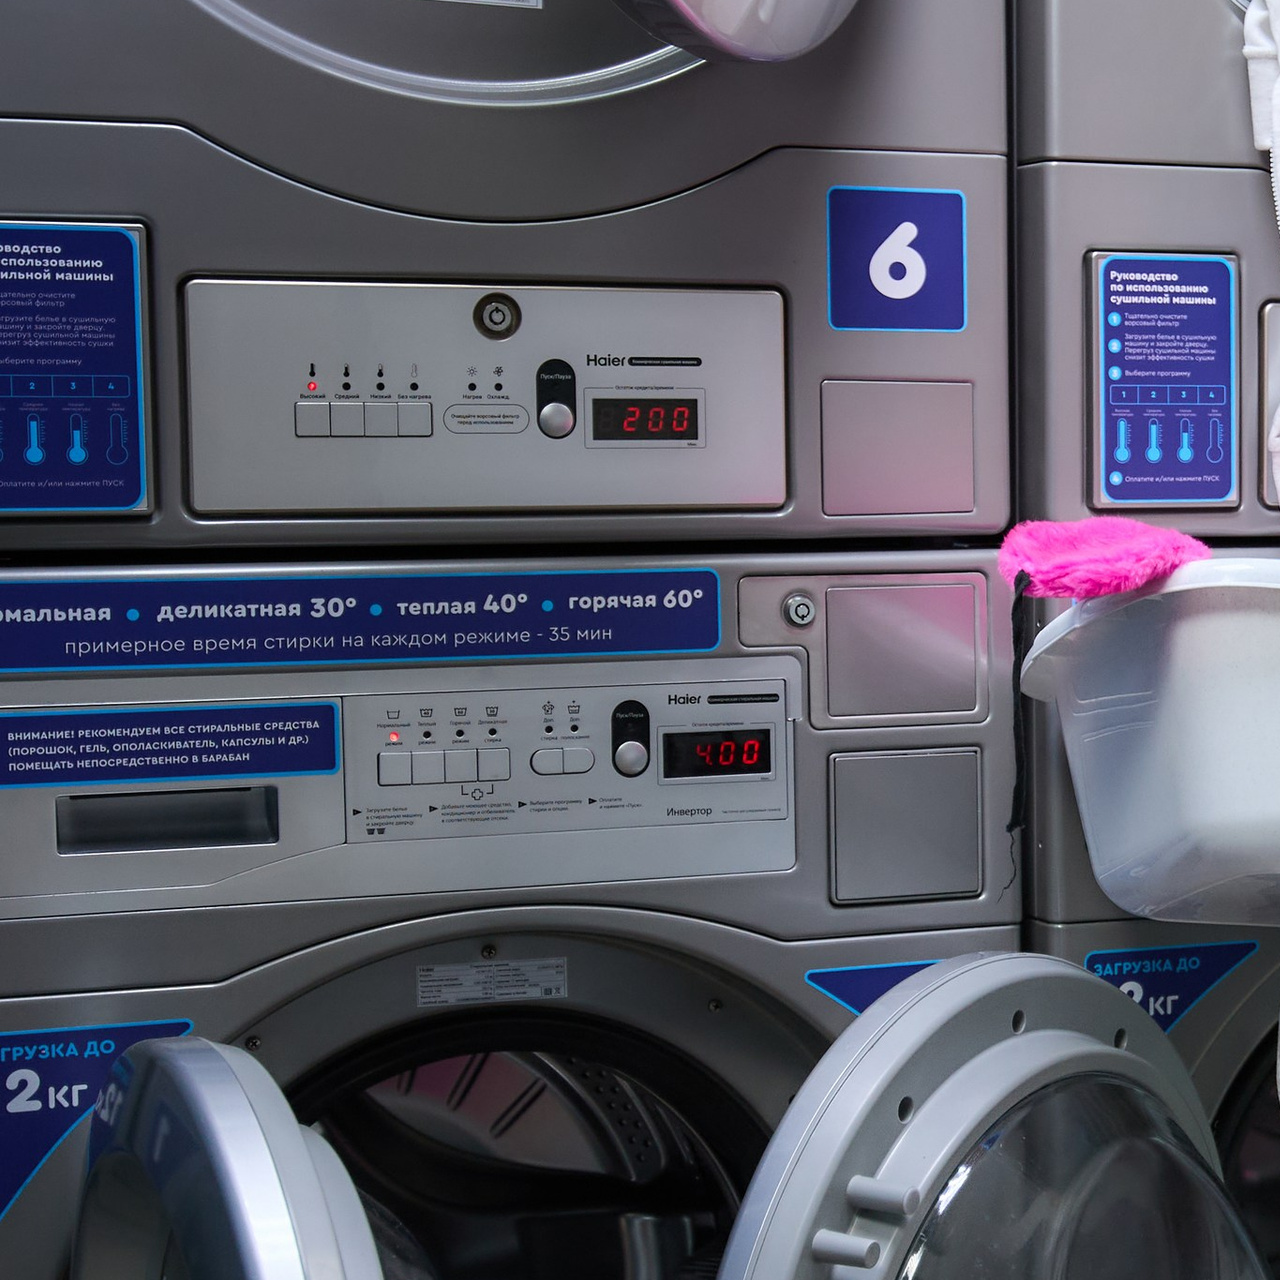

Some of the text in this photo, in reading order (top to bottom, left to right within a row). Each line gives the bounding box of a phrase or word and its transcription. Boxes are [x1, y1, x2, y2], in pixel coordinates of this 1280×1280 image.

[869, 220, 927, 300] 6
[55, 272, 114, 281] машины
[1110, 271, 1178, 282] Руководство
[1110, 284, 1208, 293] по использованию
[1110, 294, 1216, 305] сушильной машины
[586, 354, 625, 366] Haier
[623, 407, 689, 432] 200
[0, 589, 702, 622] мальная деликатная 30° теплая 40° горячая 60°
[66, 627, 611, 657] примерное время стирки на каждом режиме 35 мин
[668, 694, 702, 705] Haier
[8, 721, 319, 740] ВНИМАНИЕ! РЕКОМЕНДУЕМ ВСЕ СТИРАЛЬНЫЕ СРЕДСТВА
[9, 746, 81, 756] (ПОРОШОК,
[80, 745, 109, 753] ГЕЛЬ,
[113, 740, 218, 751] ОПОЛАСКИВАТЕЛЬ,
[222, 738, 274, 746] КАПСУЛЫ
[288, 735, 308, 745] ДР.)
[9, 753, 249, 771] ПОМЕЩАТЬ НЕПОСРЕДСТВЕННО В БАРАБАН
[667, 808, 712, 818] Инвертор
[1093, 957, 1200, 977] ЗАГРУЗКА ДО
[84, 1040, 115, 1058] ДО
